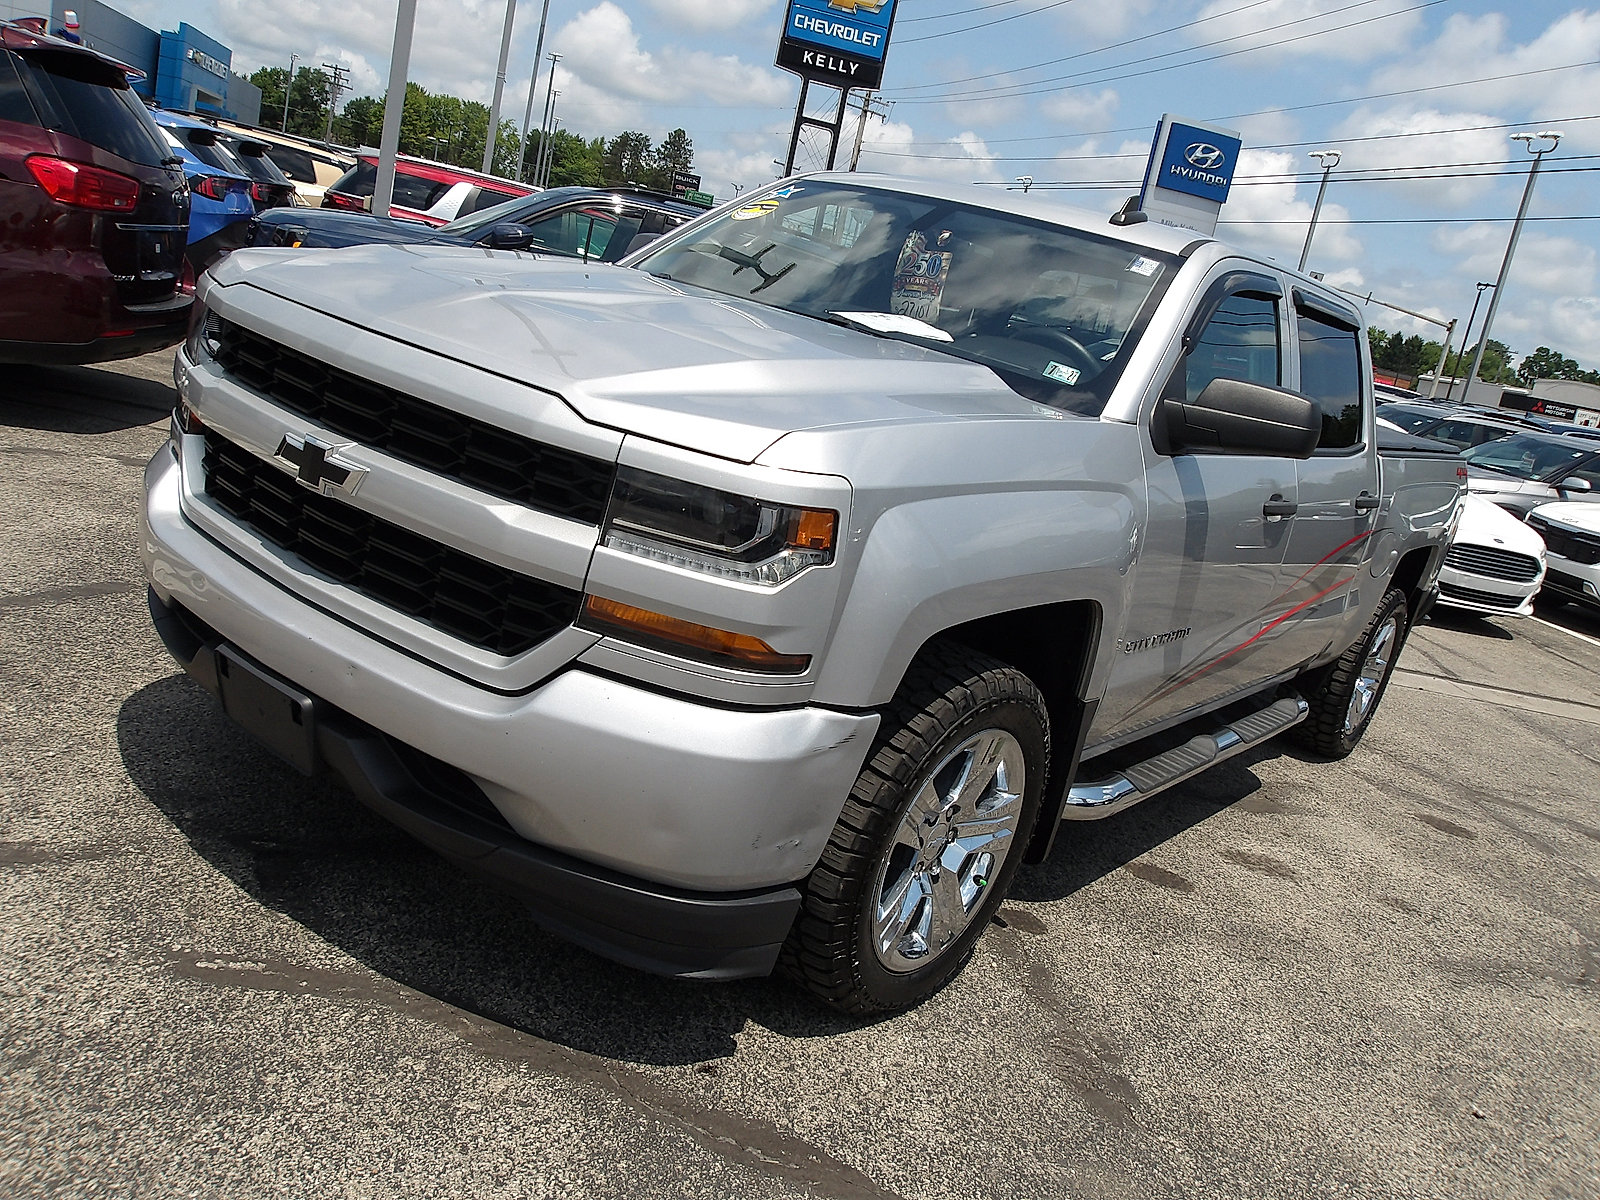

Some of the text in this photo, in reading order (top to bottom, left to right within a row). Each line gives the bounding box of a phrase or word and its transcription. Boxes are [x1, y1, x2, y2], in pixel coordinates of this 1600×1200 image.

[794, 13, 882, 47] CHEVROLET
[802, 50, 859, 76] KELLY
[675, 174, 699, 185] BUICK
[1170, 164, 1228, 188] HYUNDAI
[900, 251, 943, 279] 250
[905, 277, 929, 285] YEARS
[1544, 408, 1566, 417] MOTORS
[1545, 404, 1576, 414] MITSUBISHI
